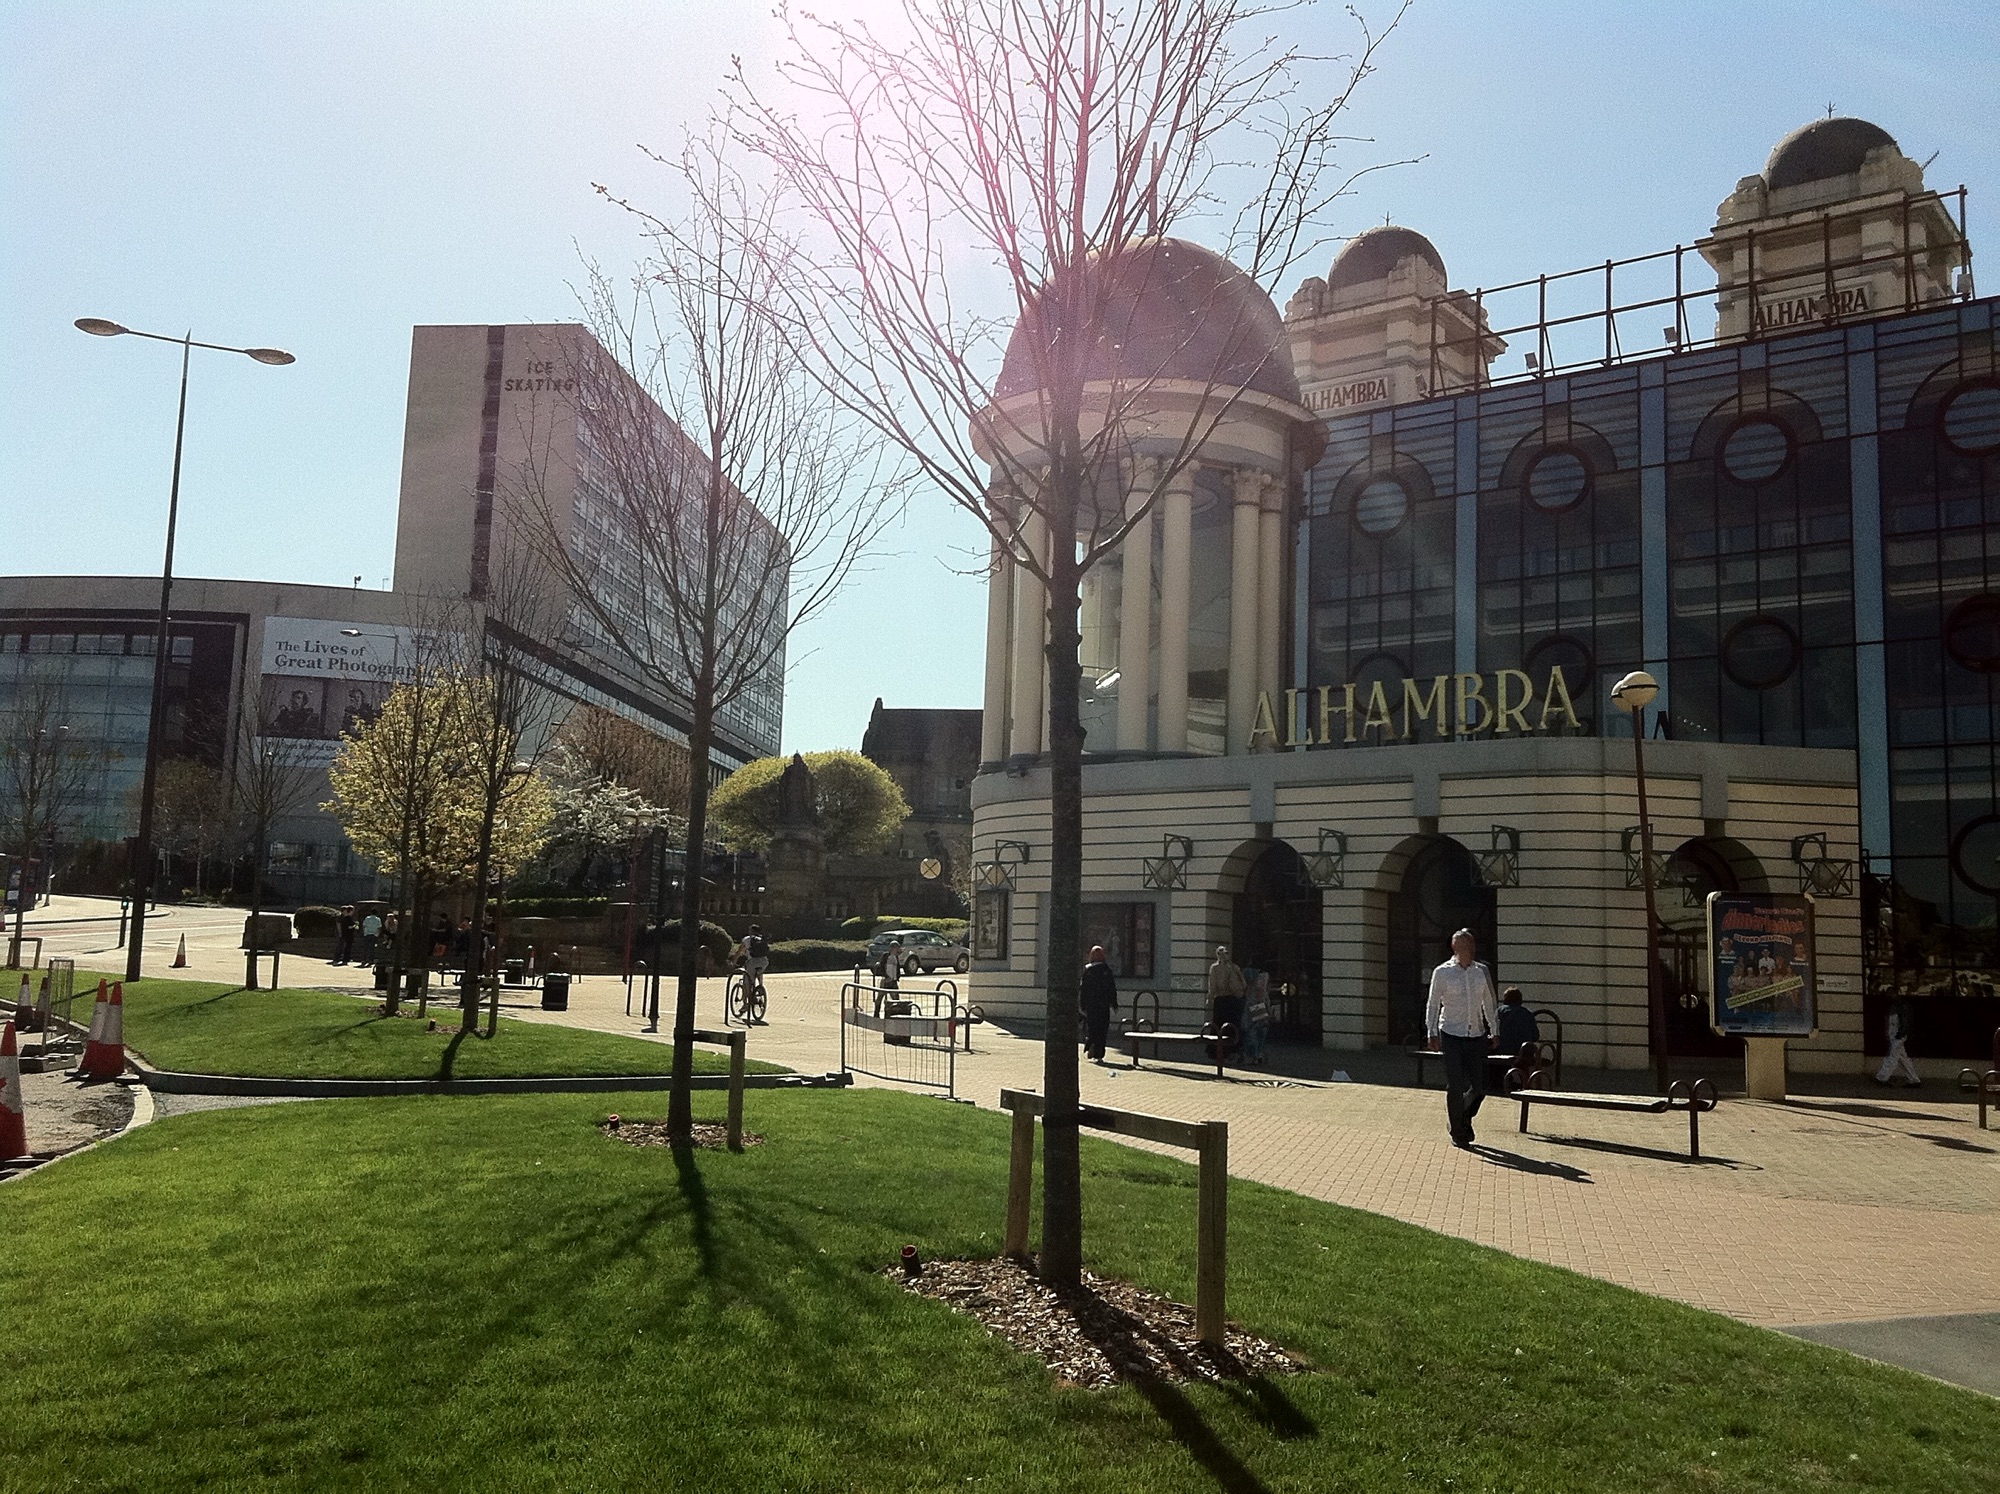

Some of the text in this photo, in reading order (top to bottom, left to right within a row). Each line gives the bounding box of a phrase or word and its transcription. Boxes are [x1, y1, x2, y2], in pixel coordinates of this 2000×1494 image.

[527, 360, 553, 374] ICE
[504, 378, 574, 392] SKATING
[1301, 378, 1388, 411] ALHAMBRA
[275, 640, 366, 657] The Lives of
[275, 654, 322, 669] Great
[1250, 665, 1581, 749] ALHAMBRA
